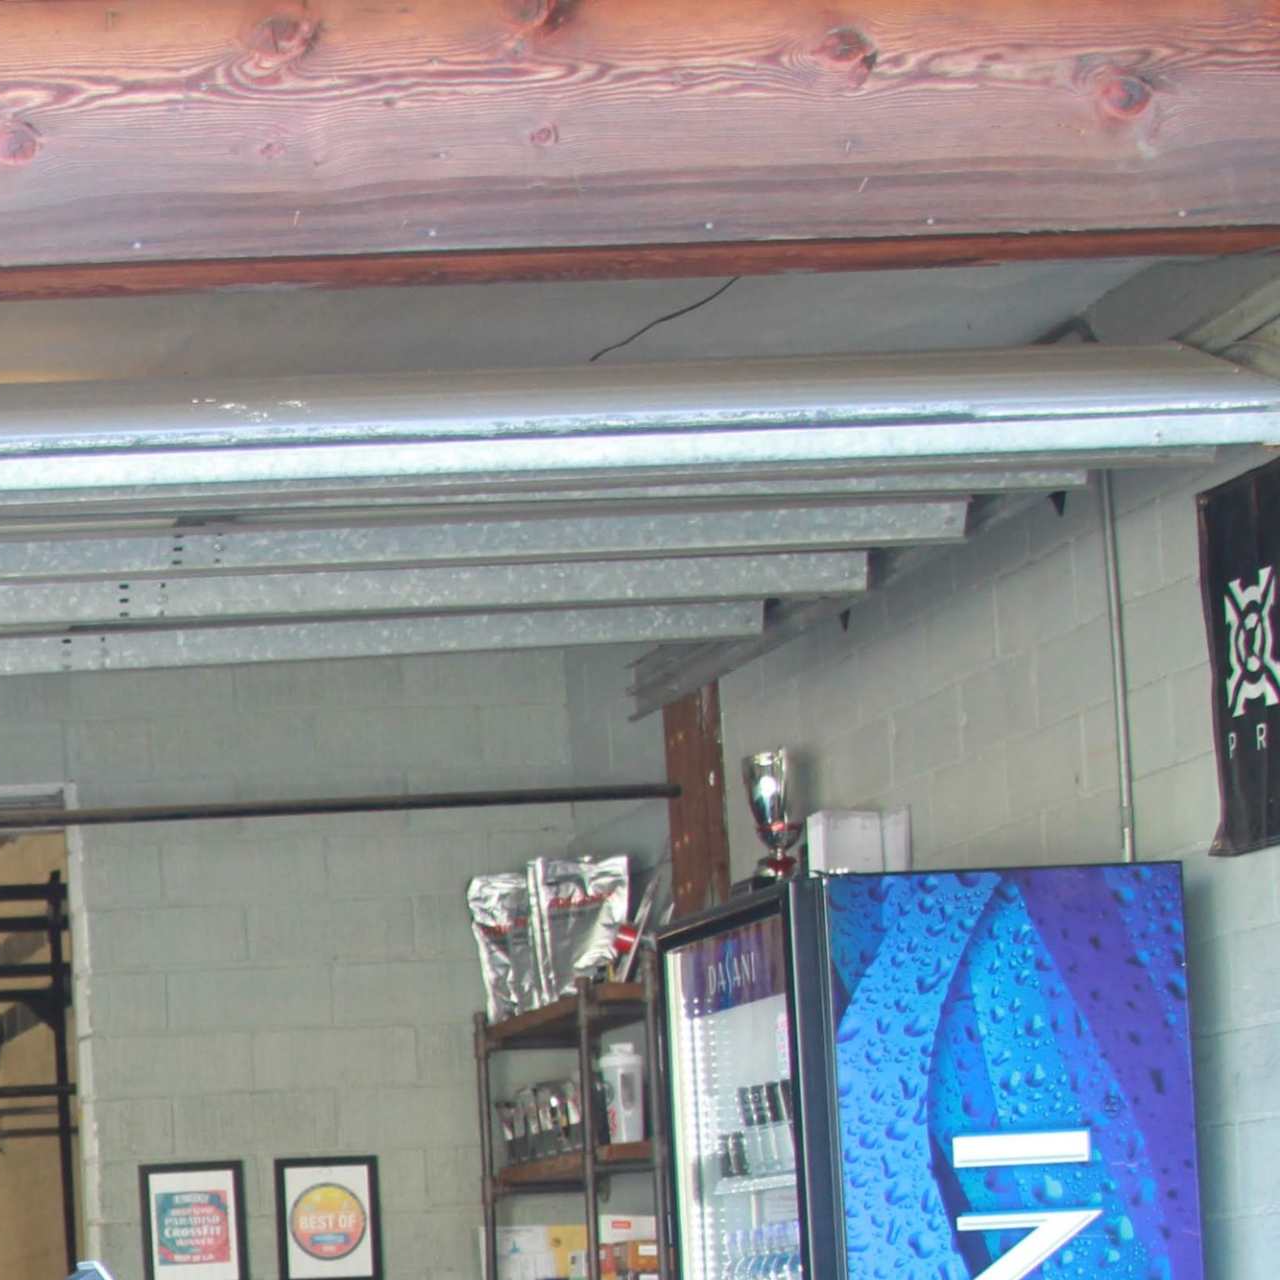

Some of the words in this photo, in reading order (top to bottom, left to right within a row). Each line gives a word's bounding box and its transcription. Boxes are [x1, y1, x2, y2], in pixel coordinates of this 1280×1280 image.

[708, 949, 756, 995] DASANI
[299, 1215, 334, 1231] BEST
[338, 1213, 357, 1229] OF
